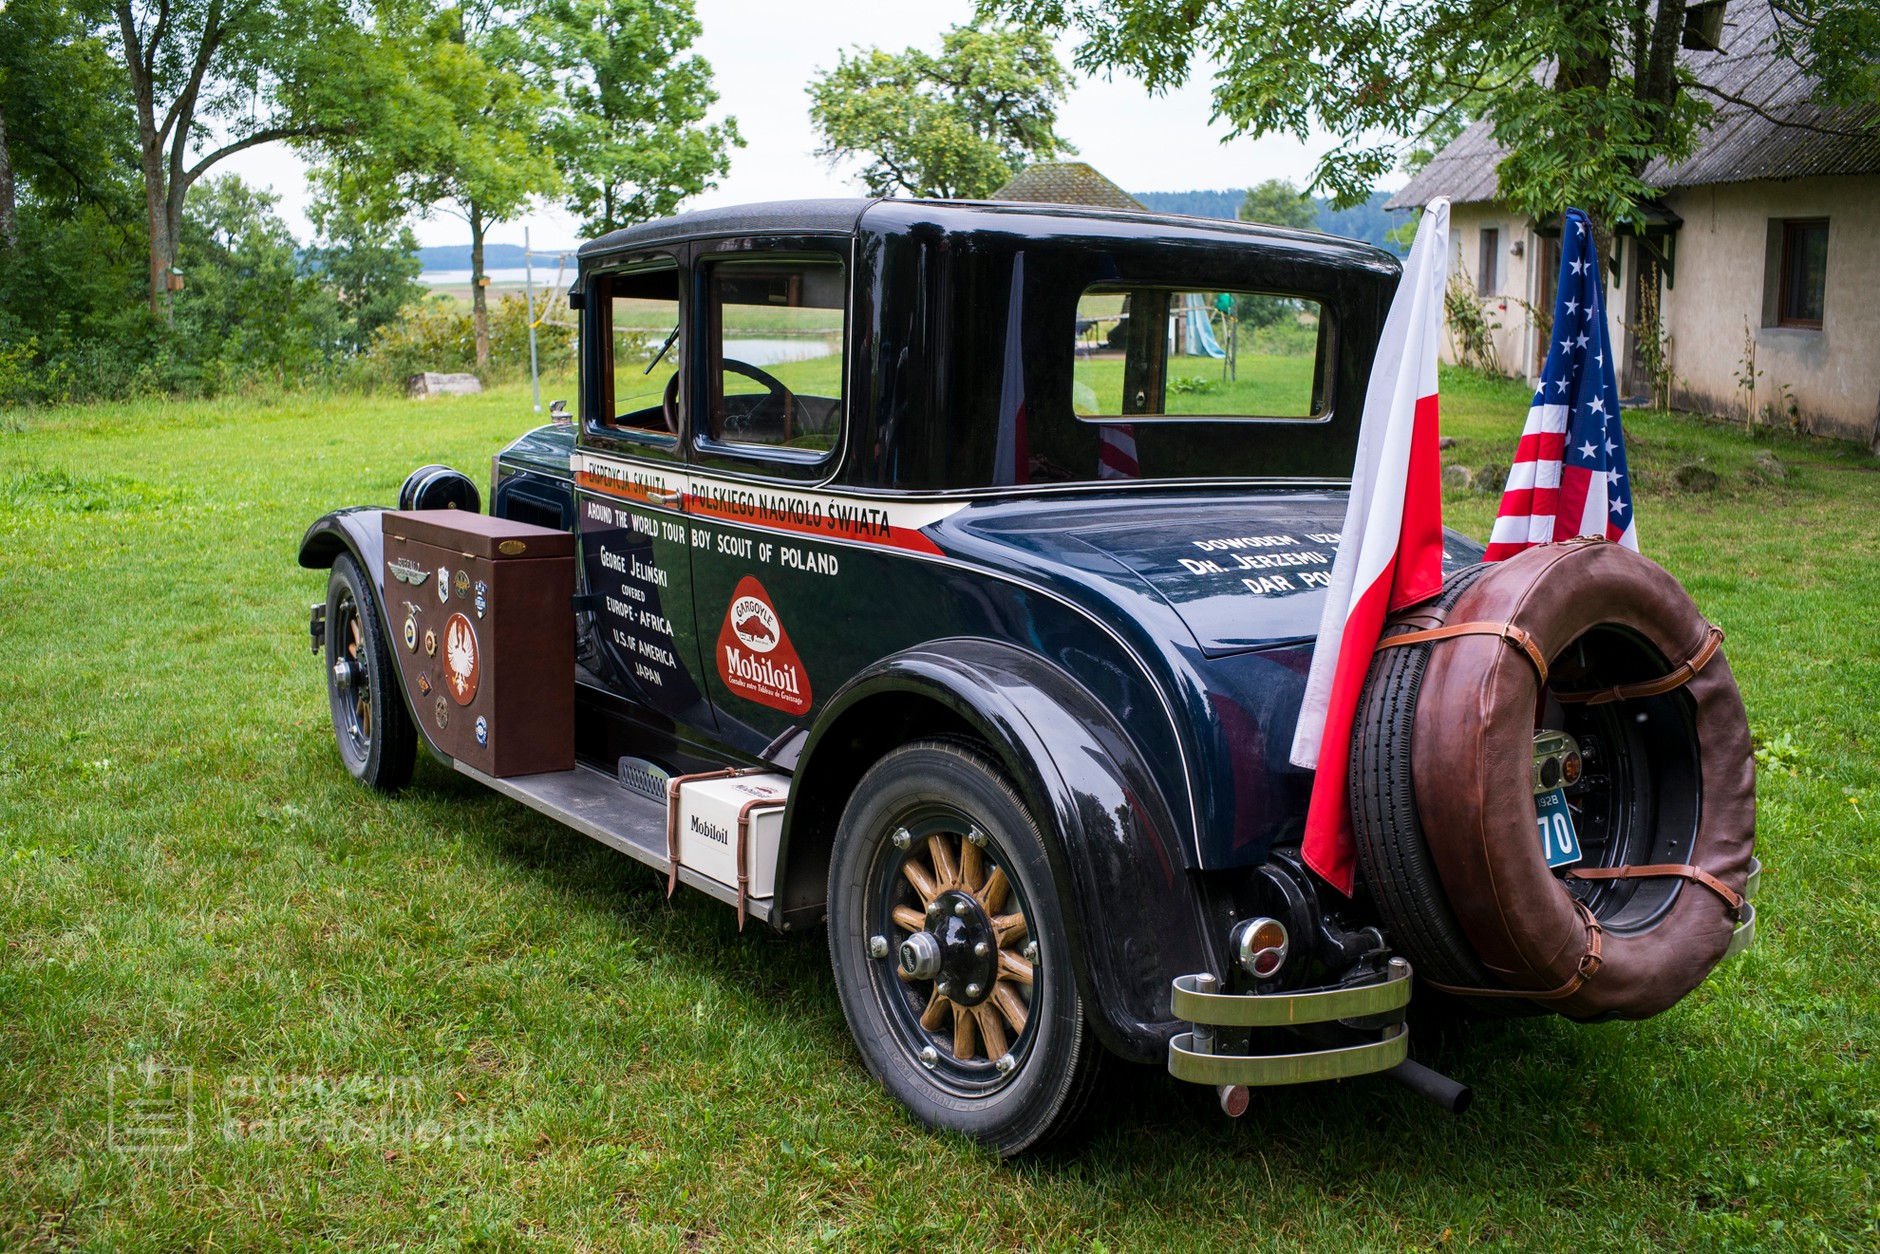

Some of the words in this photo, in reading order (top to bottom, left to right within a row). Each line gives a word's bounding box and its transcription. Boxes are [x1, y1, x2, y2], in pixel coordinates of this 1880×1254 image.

[589, 463, 630, 492] EKSPEDYCJA
[633, 472, 666, 496] SKAUTA
[691, 483, 755, 517] POLSKIEGO
[759, 493, 822, 527] NAOKOŁO
[828, 499, 891, 538] ŚWIATA
[588, 502, 612, 524] AROUND
[615, 510, 628, 528] THE
[631, 513, 659, 537] WORLD
[662, 521, 686, 544] TOUR
[691, 529, 711, 551] BOY
[717, 534, 752, 560] SCOUT
[758, 542, 772, 564] OF
[781, 547, 838, 576] POLAND
[1192, 535, 1301, 551] DOWODEM
[600, 544, 626, 573] GEORGE
[630, 554, 668, 588] JELIŃSKI
[621, 584, 646, 602] COVERED
[1241, 575, 1296, 594] DAR
[606, 596, 634, 621] EUROPE
[640, 610, 674, 637] AFRICA
[736, 600, 773, 627] GARGOYLE
[638, 640, 677, 669] AMERICA
[725, 645, 800, 694] Mobiloil
[635, 661, 662, 687] JAPAN
[1538, 795, 1558, 807] 1928
[691, 814, 728, 845] Mobiloil
[1537, 812, 1572, 860] 70
